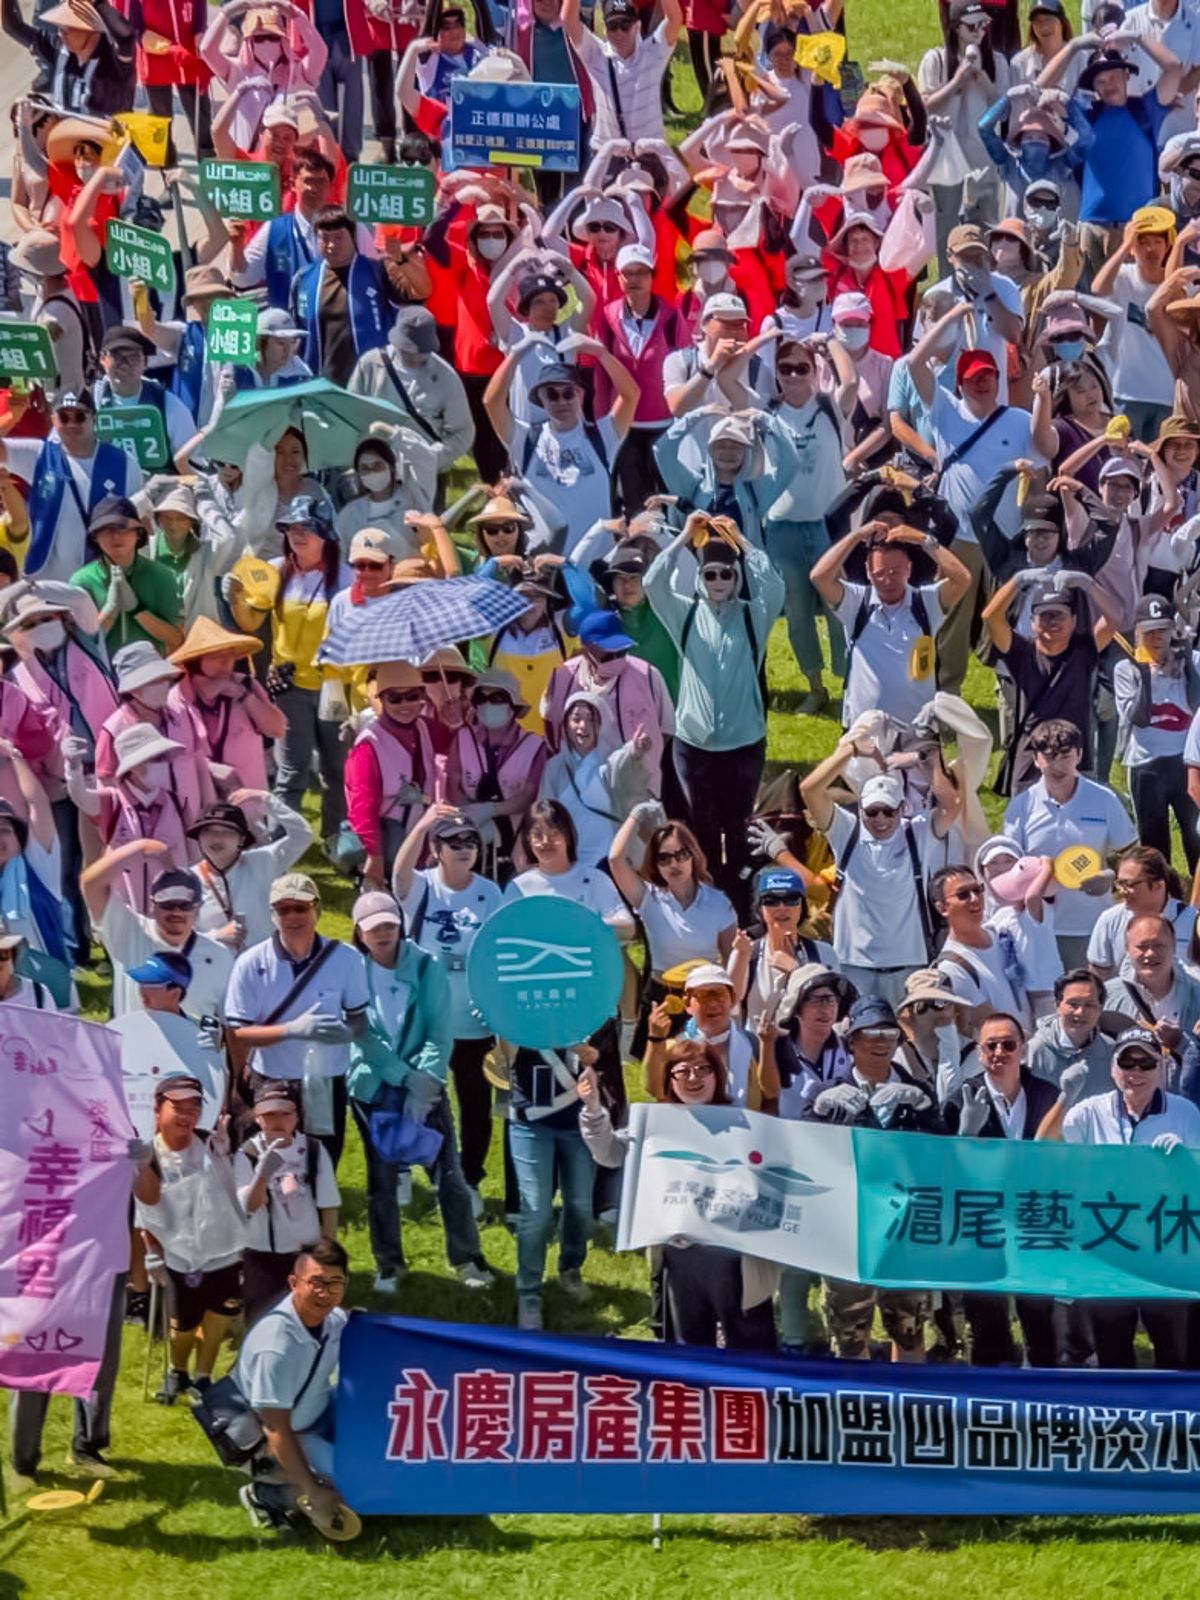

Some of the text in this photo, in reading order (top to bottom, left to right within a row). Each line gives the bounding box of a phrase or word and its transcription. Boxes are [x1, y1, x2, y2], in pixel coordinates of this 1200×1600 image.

[208, 187, 274, 213] 小組 6
[354, 192, 426, 218] 小組 5
[113, 247, 169, 285] 小組 4
[210, 328, 251, 355] 小組 3
[0, 348, 47, 371] 組 1
[143, 437, 160, 458] 2
[1149, 601, 1162, 618] C
[17, 1142, 82, 1299] 幸福里
